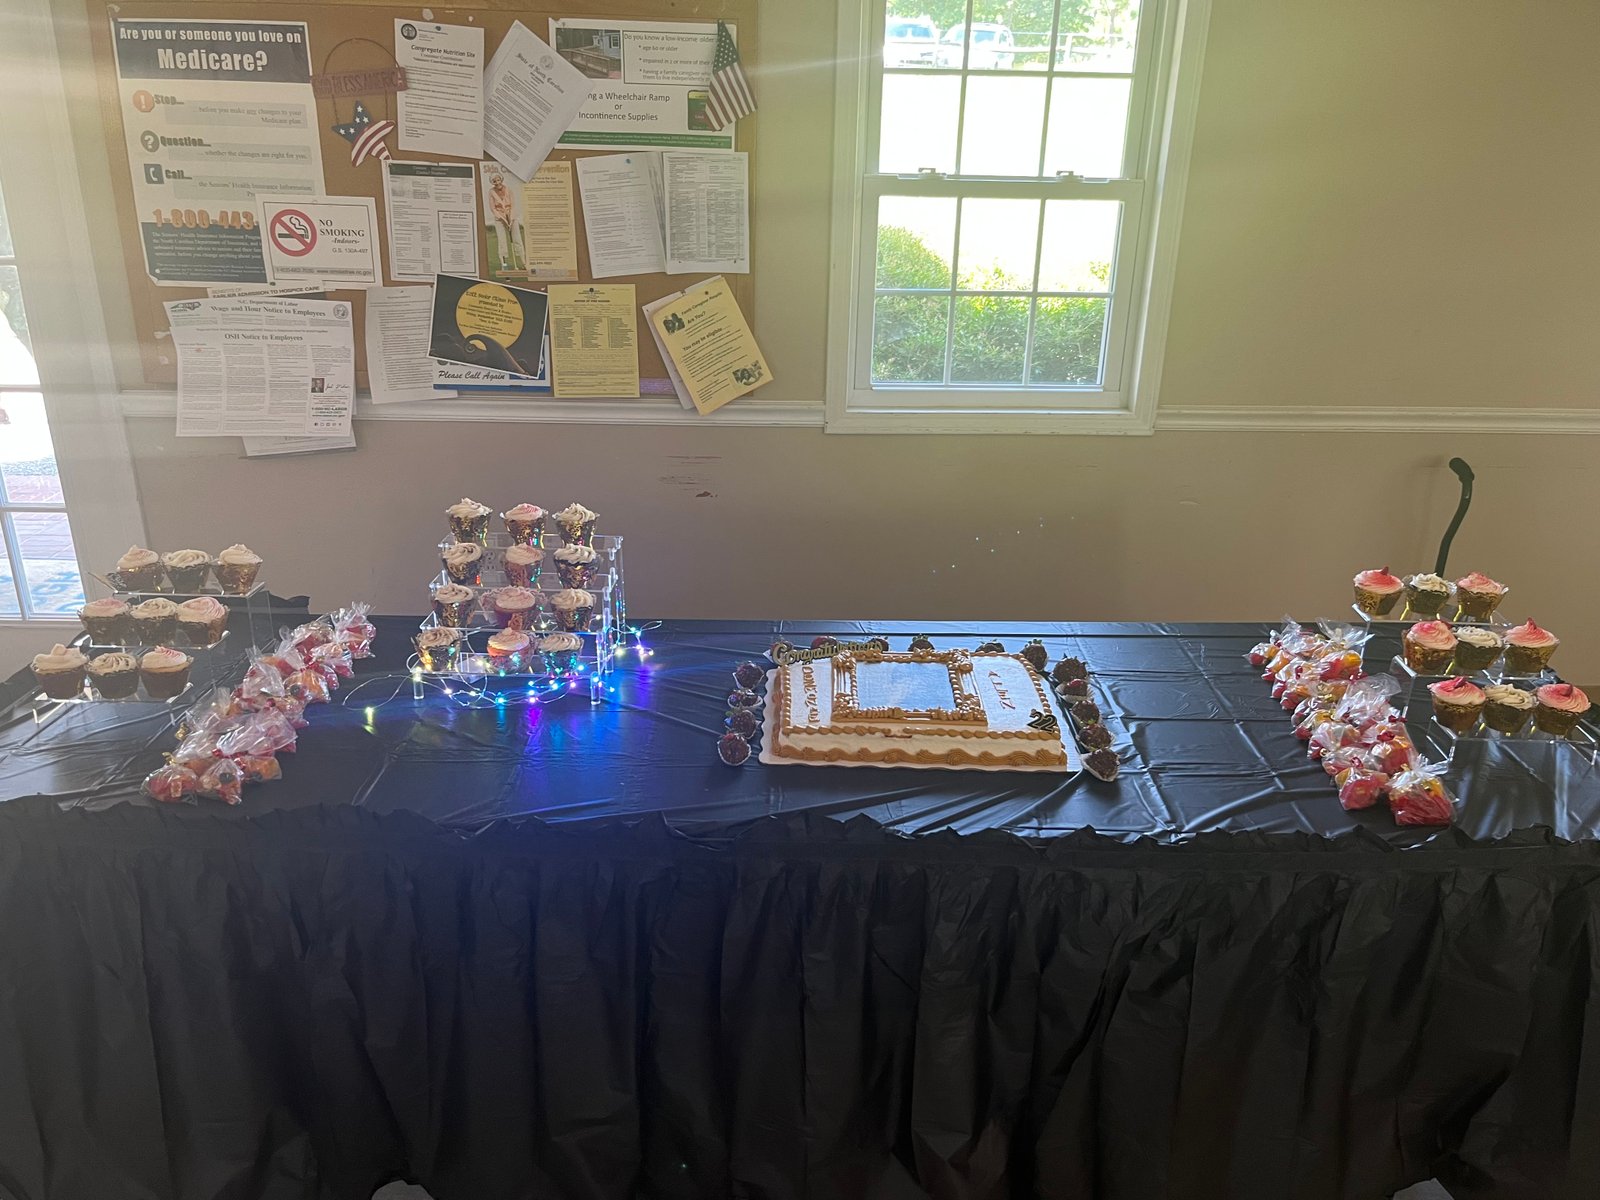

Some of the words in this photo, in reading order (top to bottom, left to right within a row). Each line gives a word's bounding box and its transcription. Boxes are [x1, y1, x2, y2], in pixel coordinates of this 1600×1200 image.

[120, 28, 139, 40] Are
[142, 30, 162, 41] you
[165, 30, 176, 40] or
[180, 31, 232, 41] someone
[236, 32, 256, 42] you
[259, 30, 283, 43] love
[286, 33, 302, 43] on
[411, 45, 442, 54] Congregate
[443, 49, 466, 57] Nutrition
[157, 48, 268, 72] Medicare?
[605, 92, 647, 101] Wheelchair
[649, 93, 670, 102] Ramp
[578, 112, 626, 121] Incontinence
[628, 112, 658, 122] Supplies
[319, 219, 333, 227] NO
[319, 229, 365, 237] SMOKING
[292, 309, 326, 317] Employees
[694, 311, 706, 321] You?
[691, 340, 701, 348] may
[438, 370, 463, 379] Please
[464, 370, 481, 379] Call
[481, 371, 506, 381] Again
[1026, 708, 1058, 734] 22
